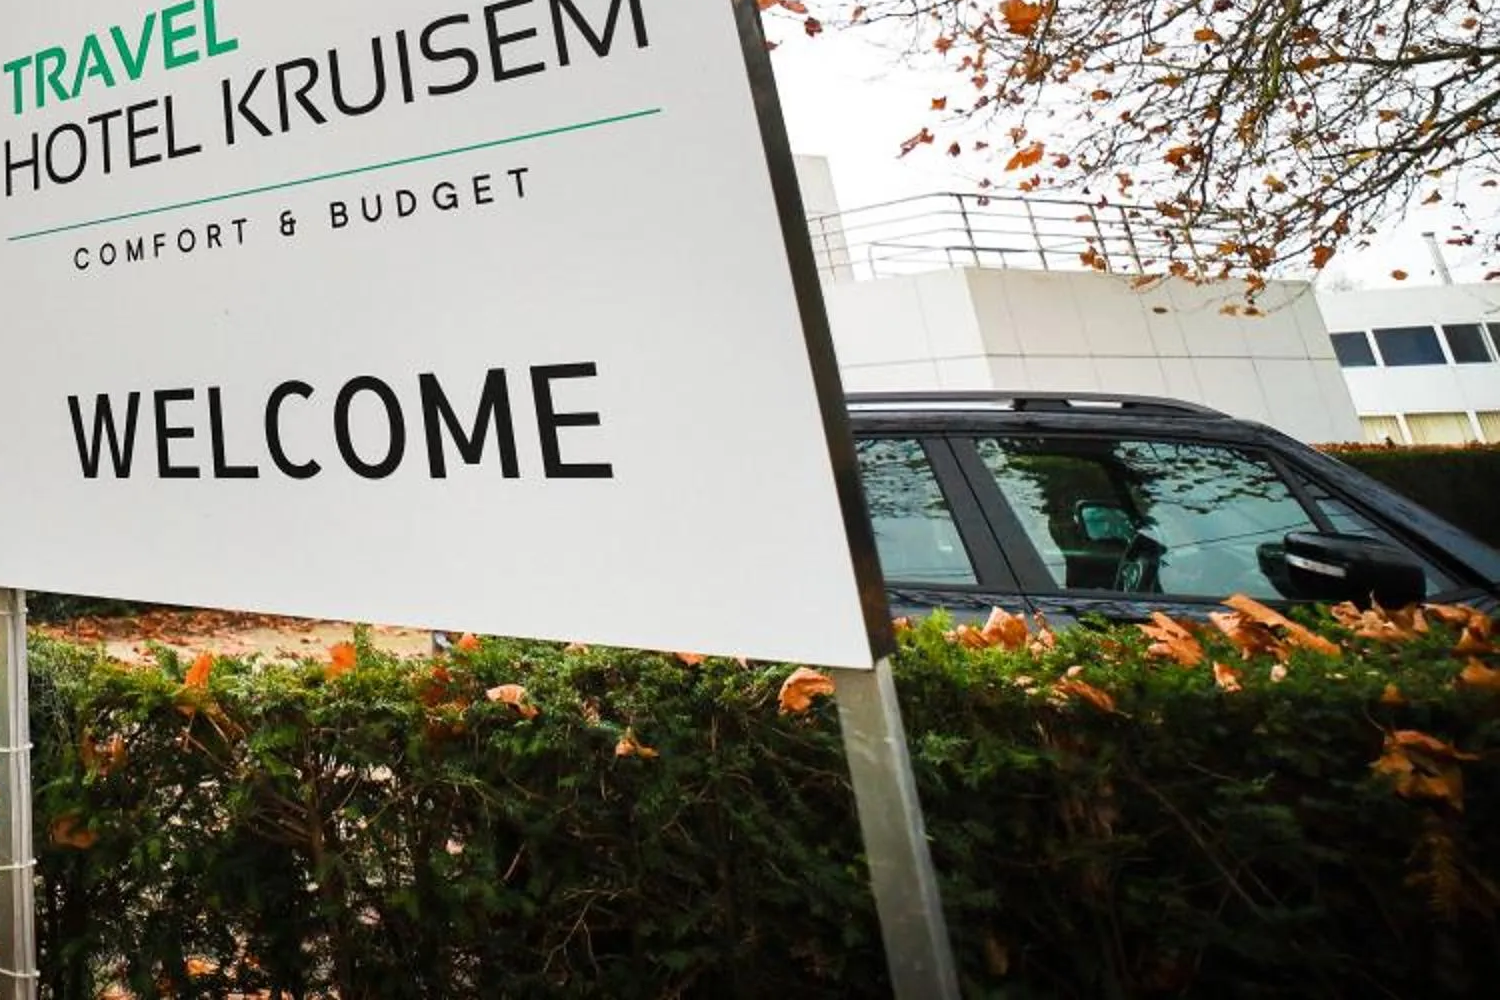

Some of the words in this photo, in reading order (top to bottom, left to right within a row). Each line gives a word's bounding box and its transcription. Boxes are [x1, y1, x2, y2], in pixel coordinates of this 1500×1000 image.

[4, 95, 202, 197] HOTEL
[73, 218, 248, 271] COMFORT
[279, 210, 297, 237] &
[329, 168, 531, 229] BUDGET
[67, 361, 614, 480] WELCOME
